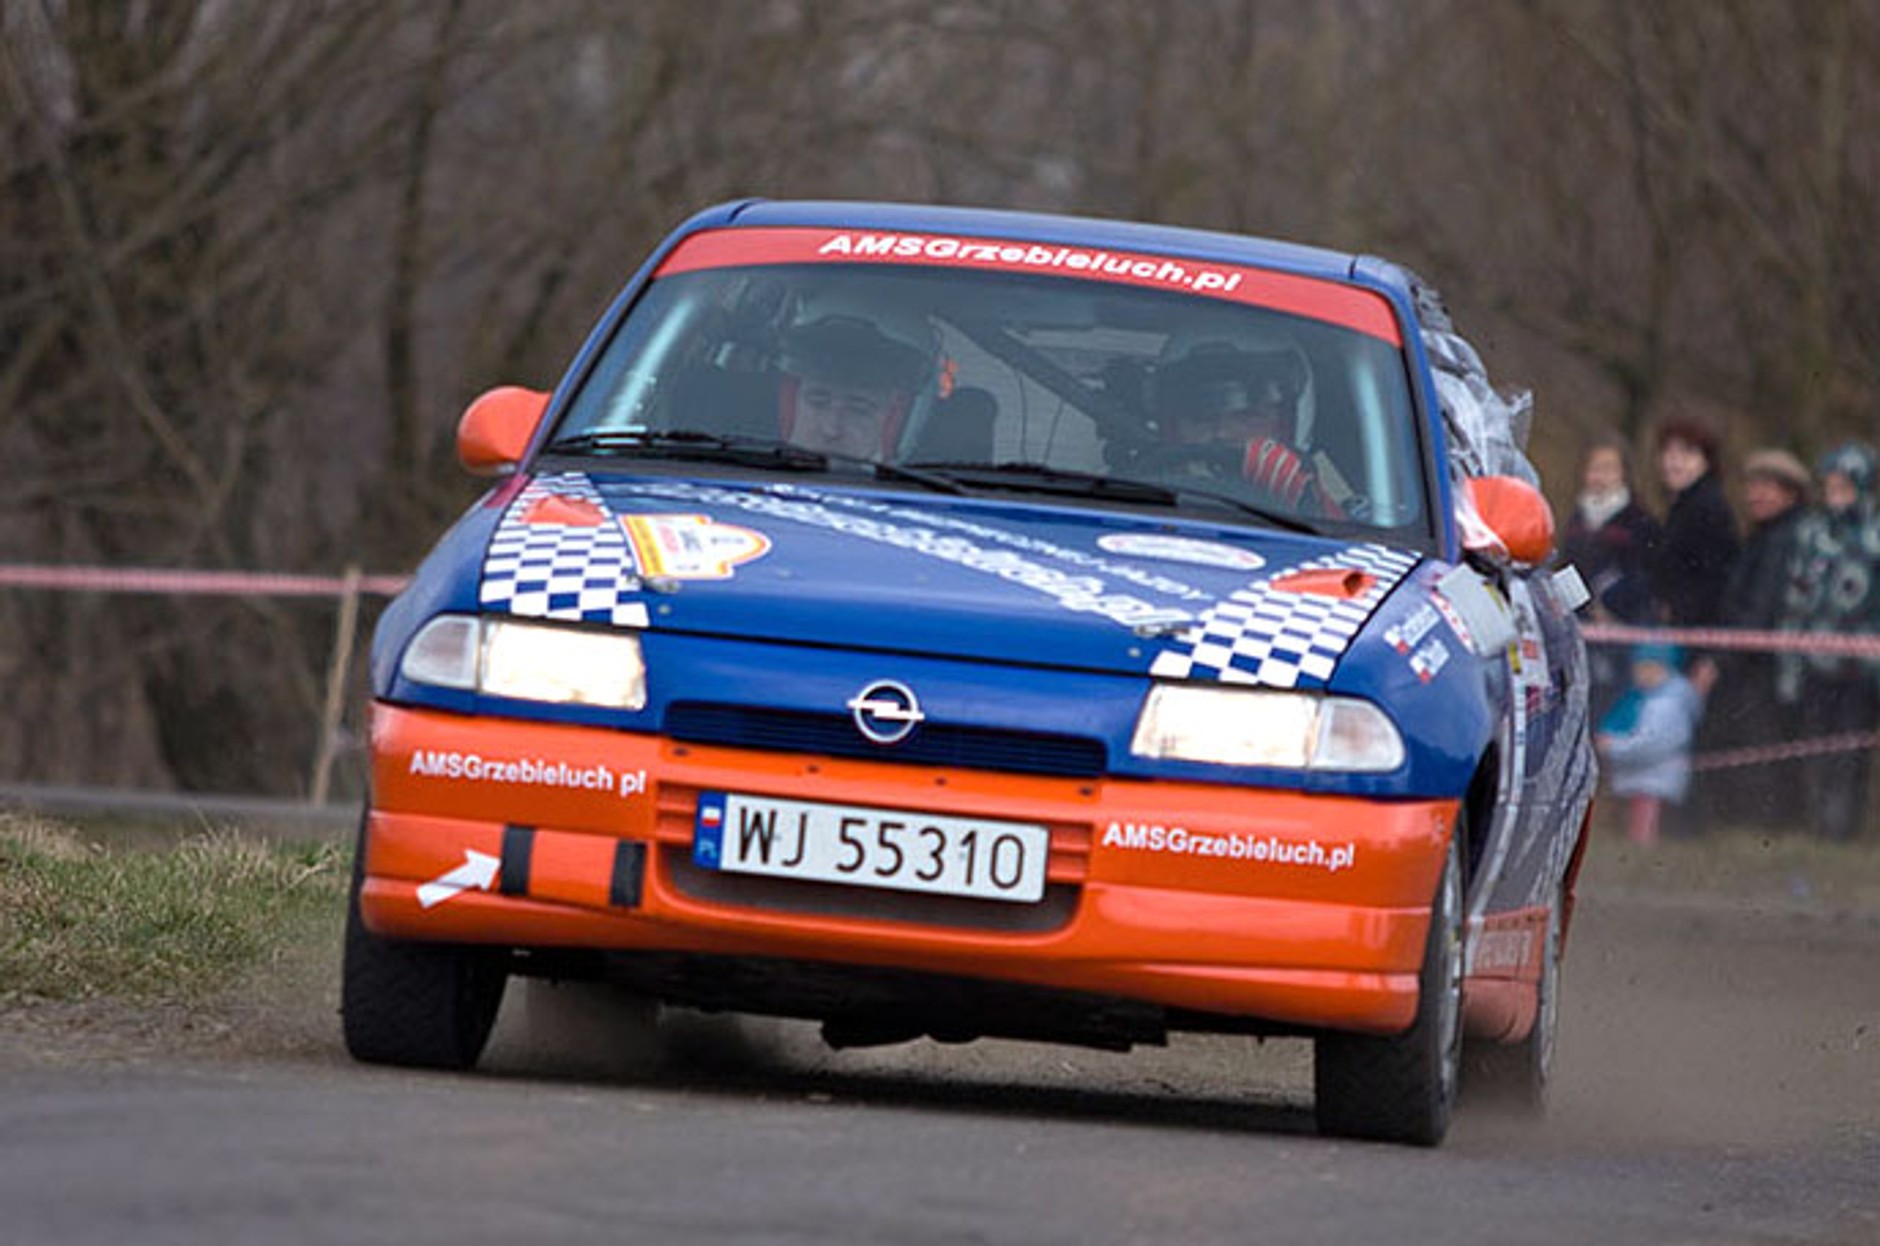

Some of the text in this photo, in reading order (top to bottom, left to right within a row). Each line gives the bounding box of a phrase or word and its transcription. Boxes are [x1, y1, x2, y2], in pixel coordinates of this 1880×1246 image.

[818, 233, 1242, 293] AMSGrzebieluch.pl
[409, 750, 613, 790] AMSGrzebieluch
[738, 806, 1026, 890] WJ 55310
[1102, 822, 1354, 870] AMSGrzebieluch.pl
